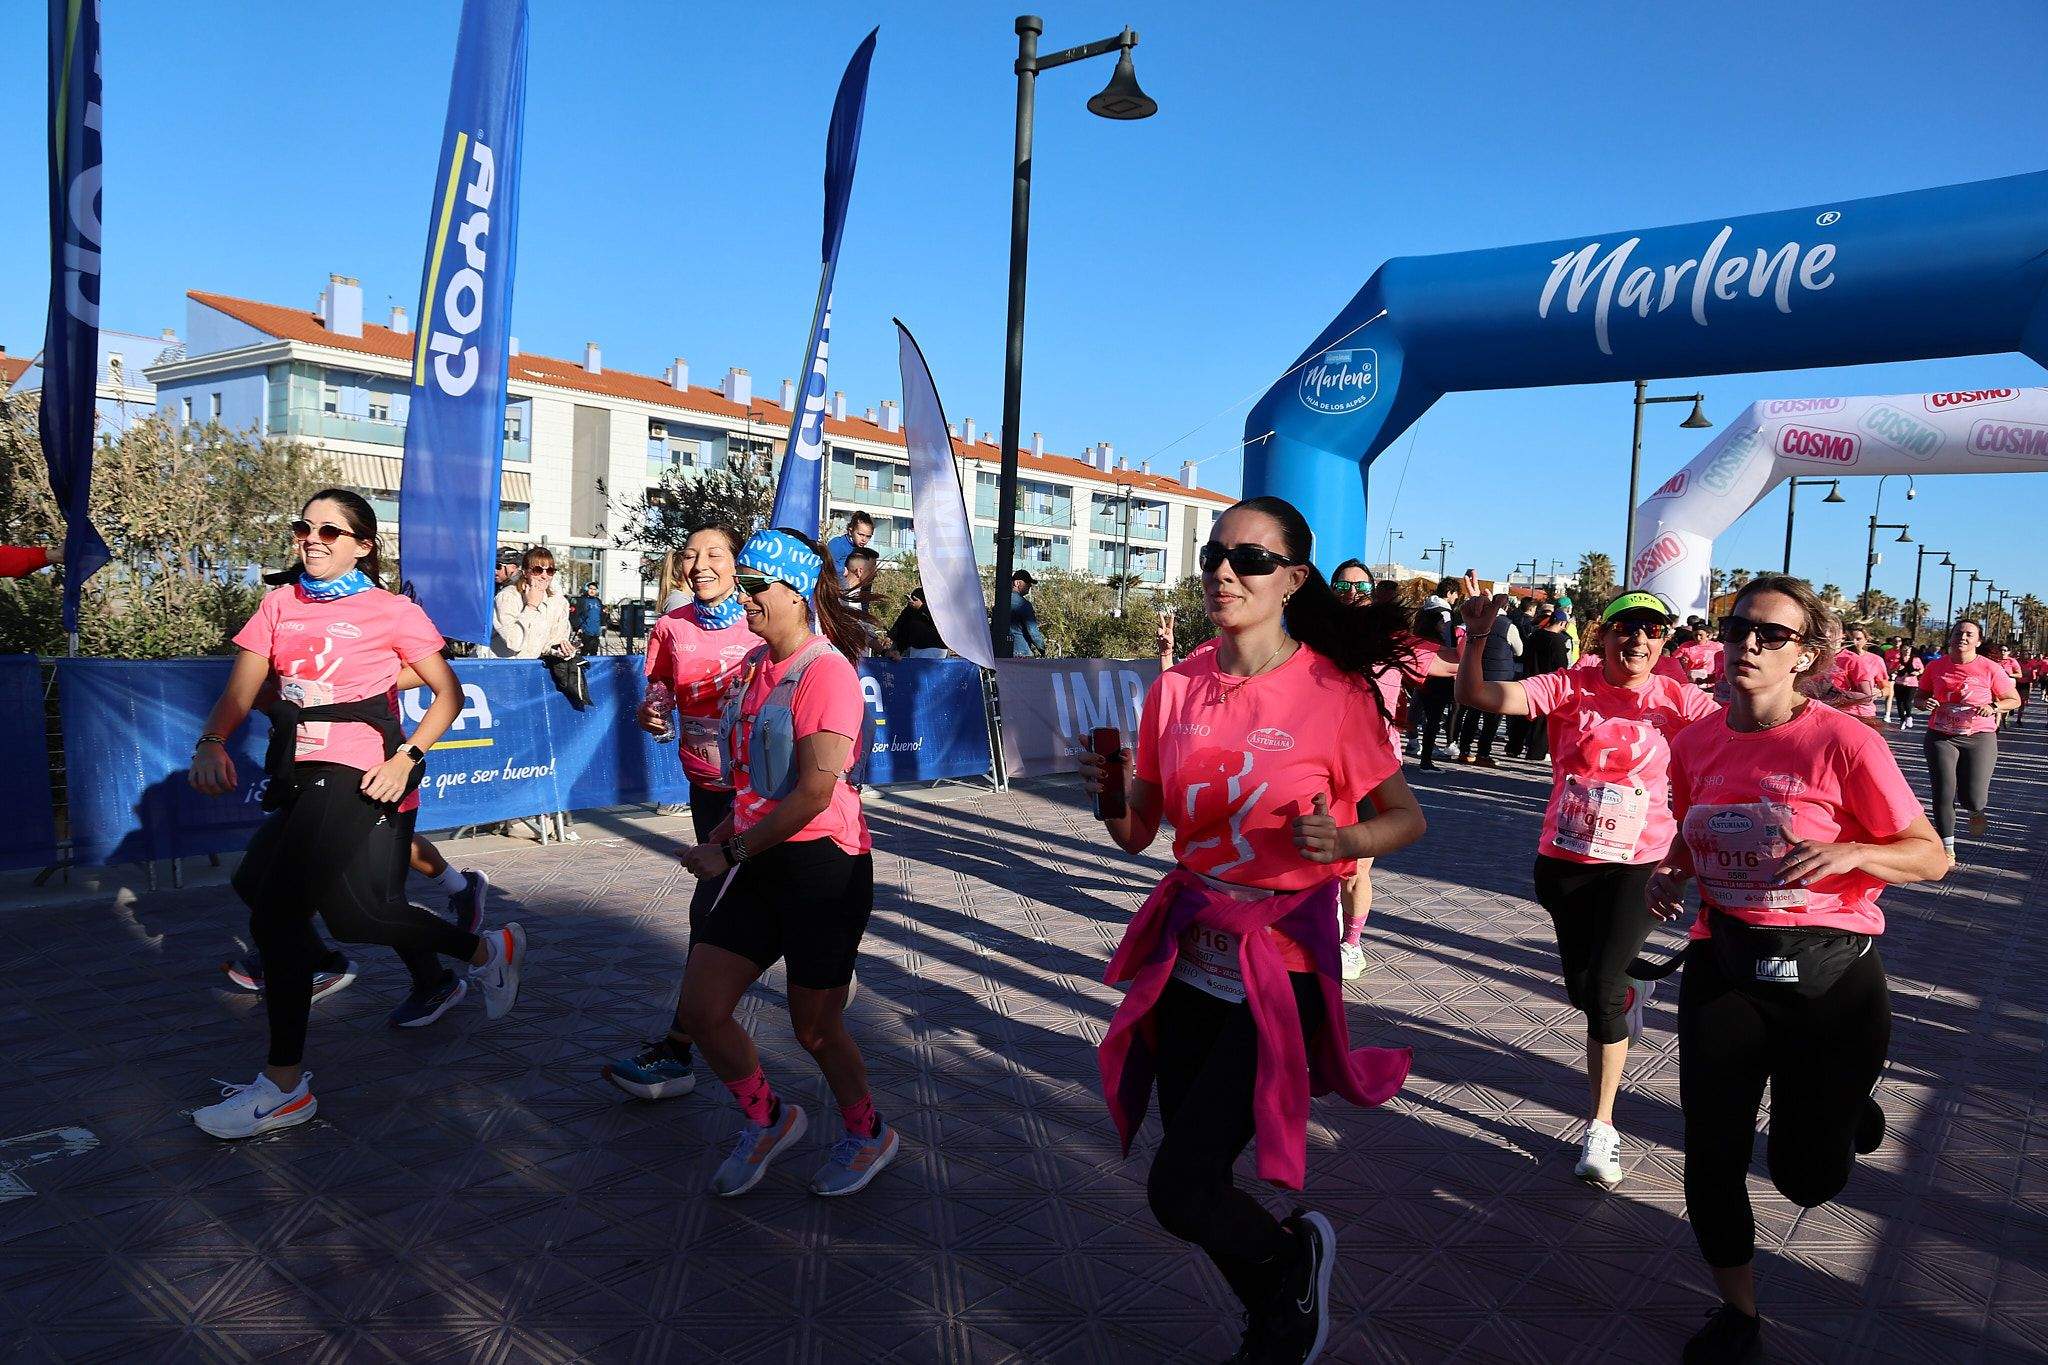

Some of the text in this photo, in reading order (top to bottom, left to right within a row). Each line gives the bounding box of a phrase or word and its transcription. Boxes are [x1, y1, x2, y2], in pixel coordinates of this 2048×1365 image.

[1538, 225, 1837, 355] Marlene
[1305, 364, 1372, 397] Marlene
[1306, 395, 1319, 407] HIJA
[1345, 395, 1367, 409] ALPES
[1867, 407, 1939, 455] COSMO
[1783, 428, 1854, 462] COSMO
[1975, 424, 2048, 457] COSM
[1632, 536, 1681, 587] COSMO
[872, 735, 923, 753] ser bueno!
[1250, 734, 1291, 747] ASTURIANA
[436, 772, 467, 799] que
[471, 769, 499, 784] ser
[502, 757, 557, 781] bueno!
[1584, 813, 1617, 831] 016
[1710, 820, 1750, 829] ASTURIANA
[1718, 850, 1760, 868] 016
[1713, 892, 1733, 900] SHO
[1753, 892, 1792, 902] Santander
[1755, 960, 1799, 977] LONDON
